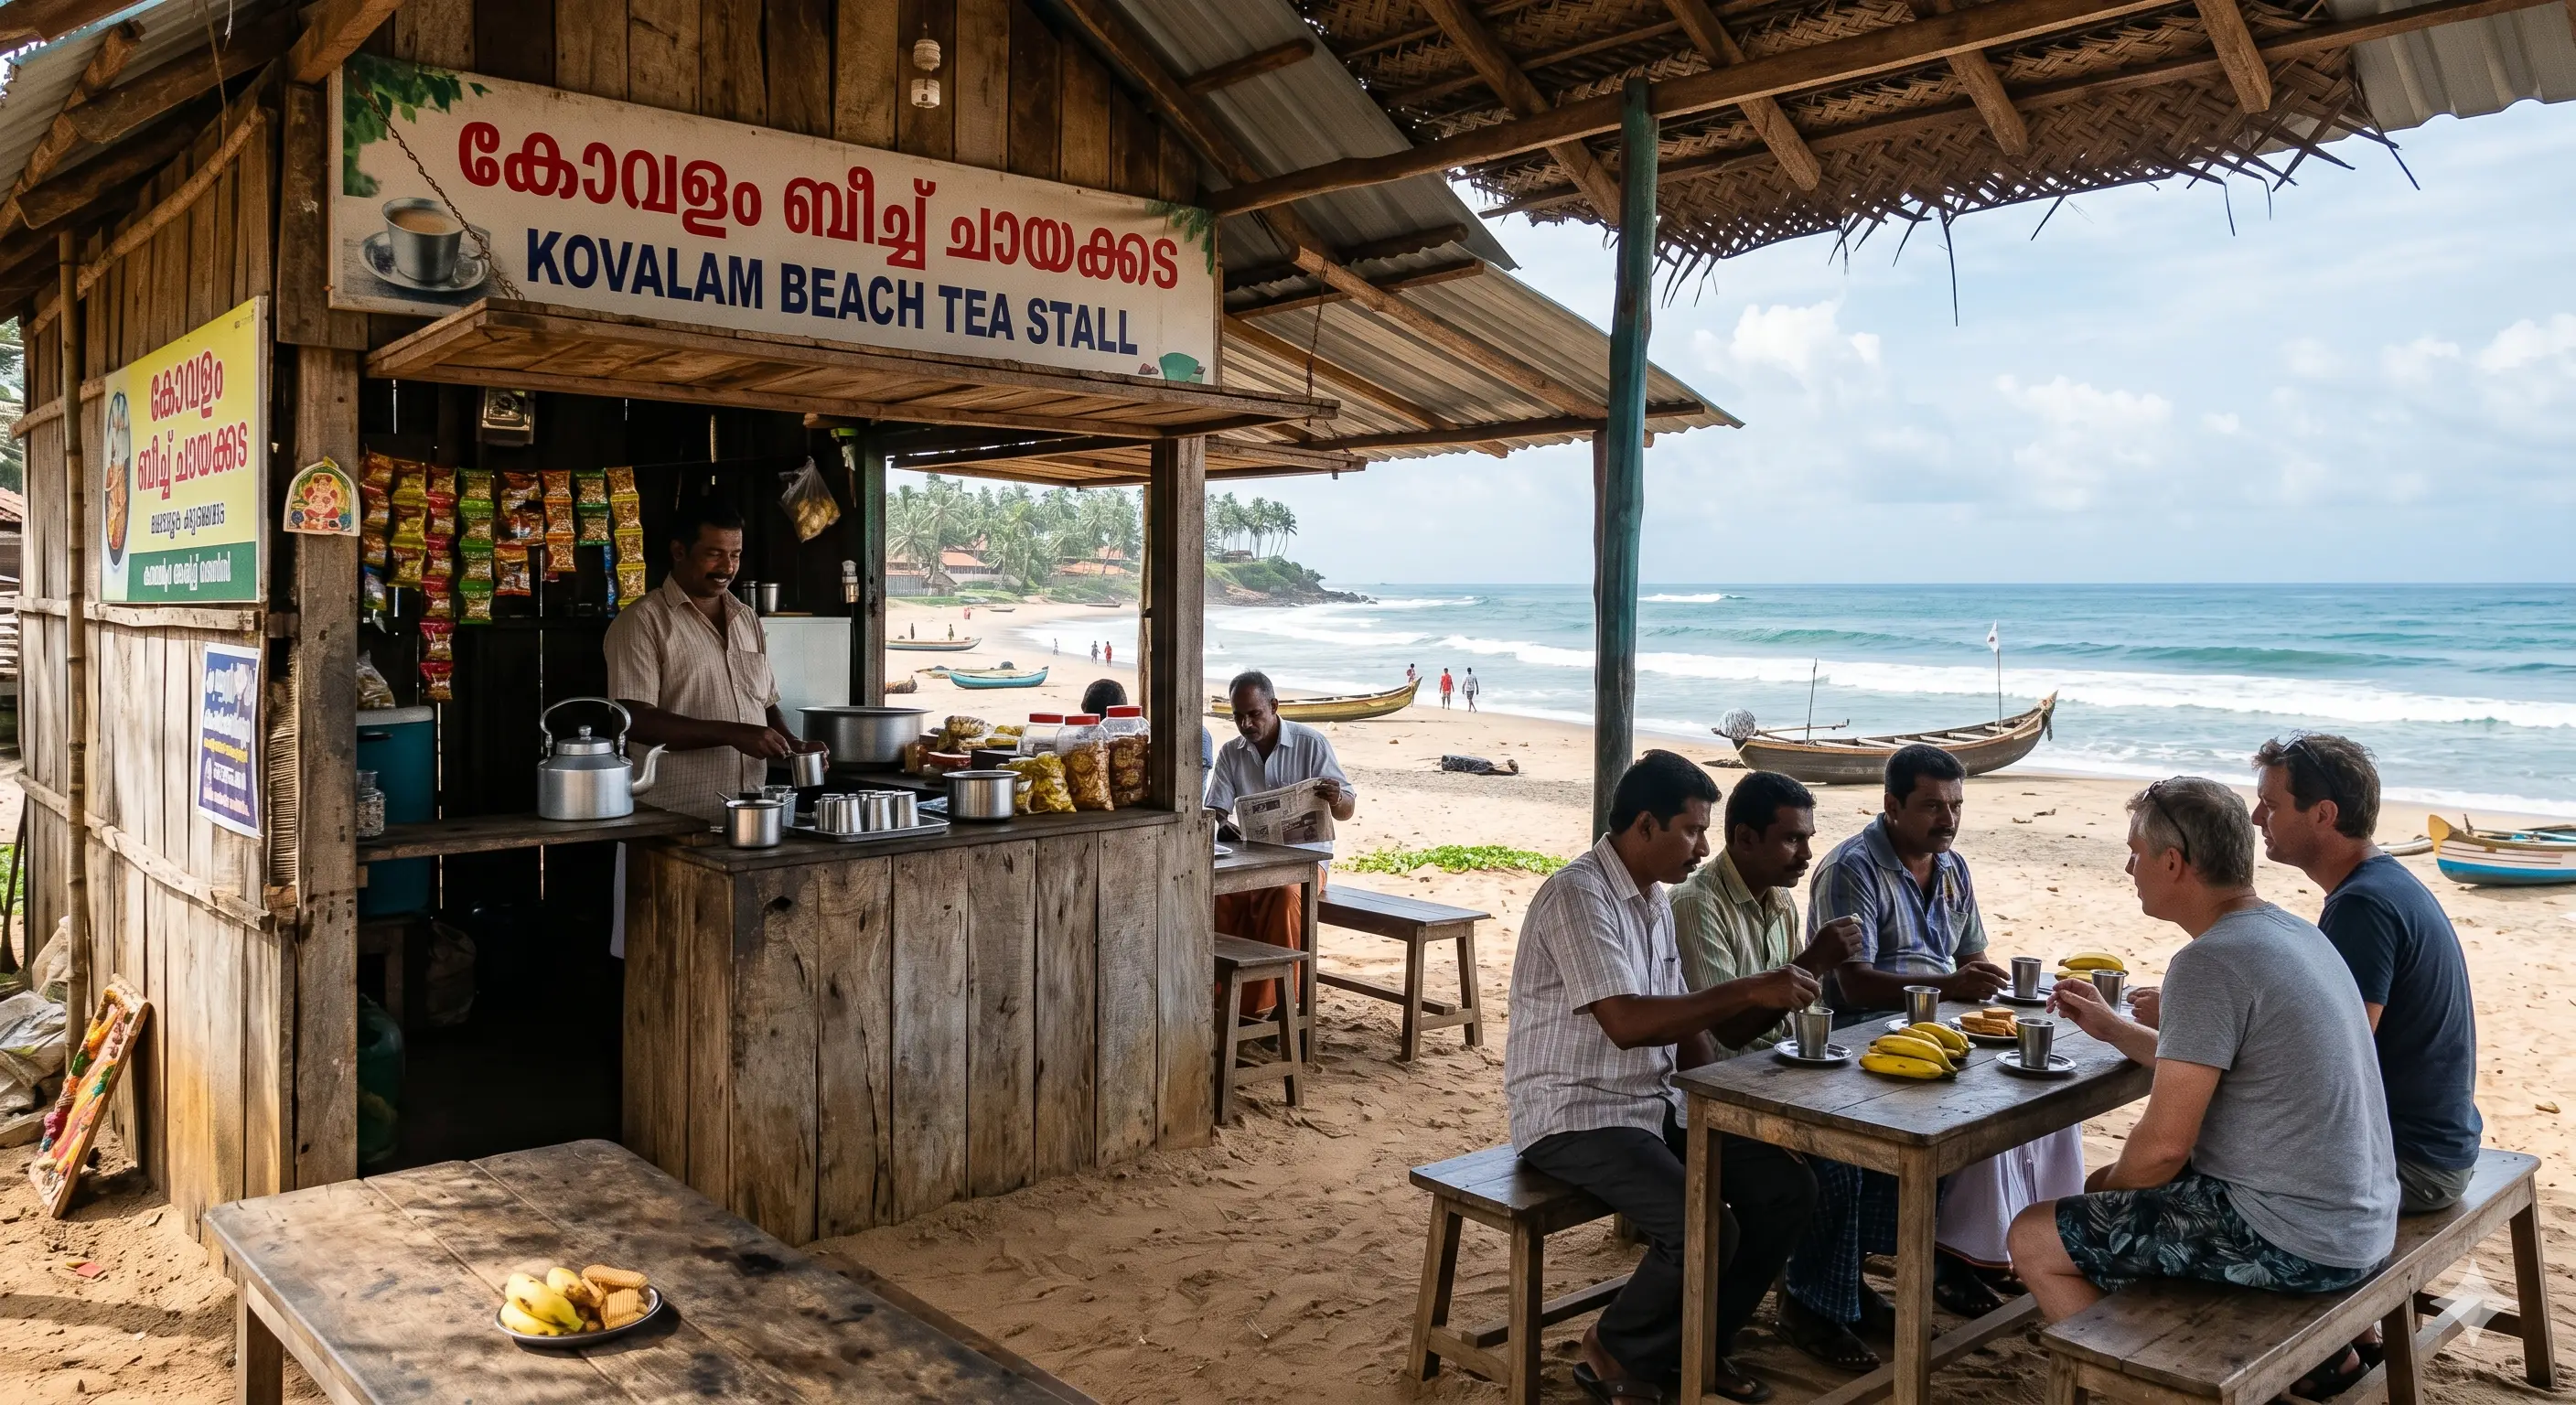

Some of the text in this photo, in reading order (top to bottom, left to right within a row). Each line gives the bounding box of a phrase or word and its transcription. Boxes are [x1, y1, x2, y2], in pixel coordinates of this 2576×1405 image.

[458, 121, 1178, 290] കോവളം ബീച്ച് ചായക്കട
[527, 227, 1138, 356] KOVALAM BEACH TEA STALL
[150, 349, 224, 423] കോവളം
[137, 421, 248, 500] ബീച്ച് ചായക്കട
